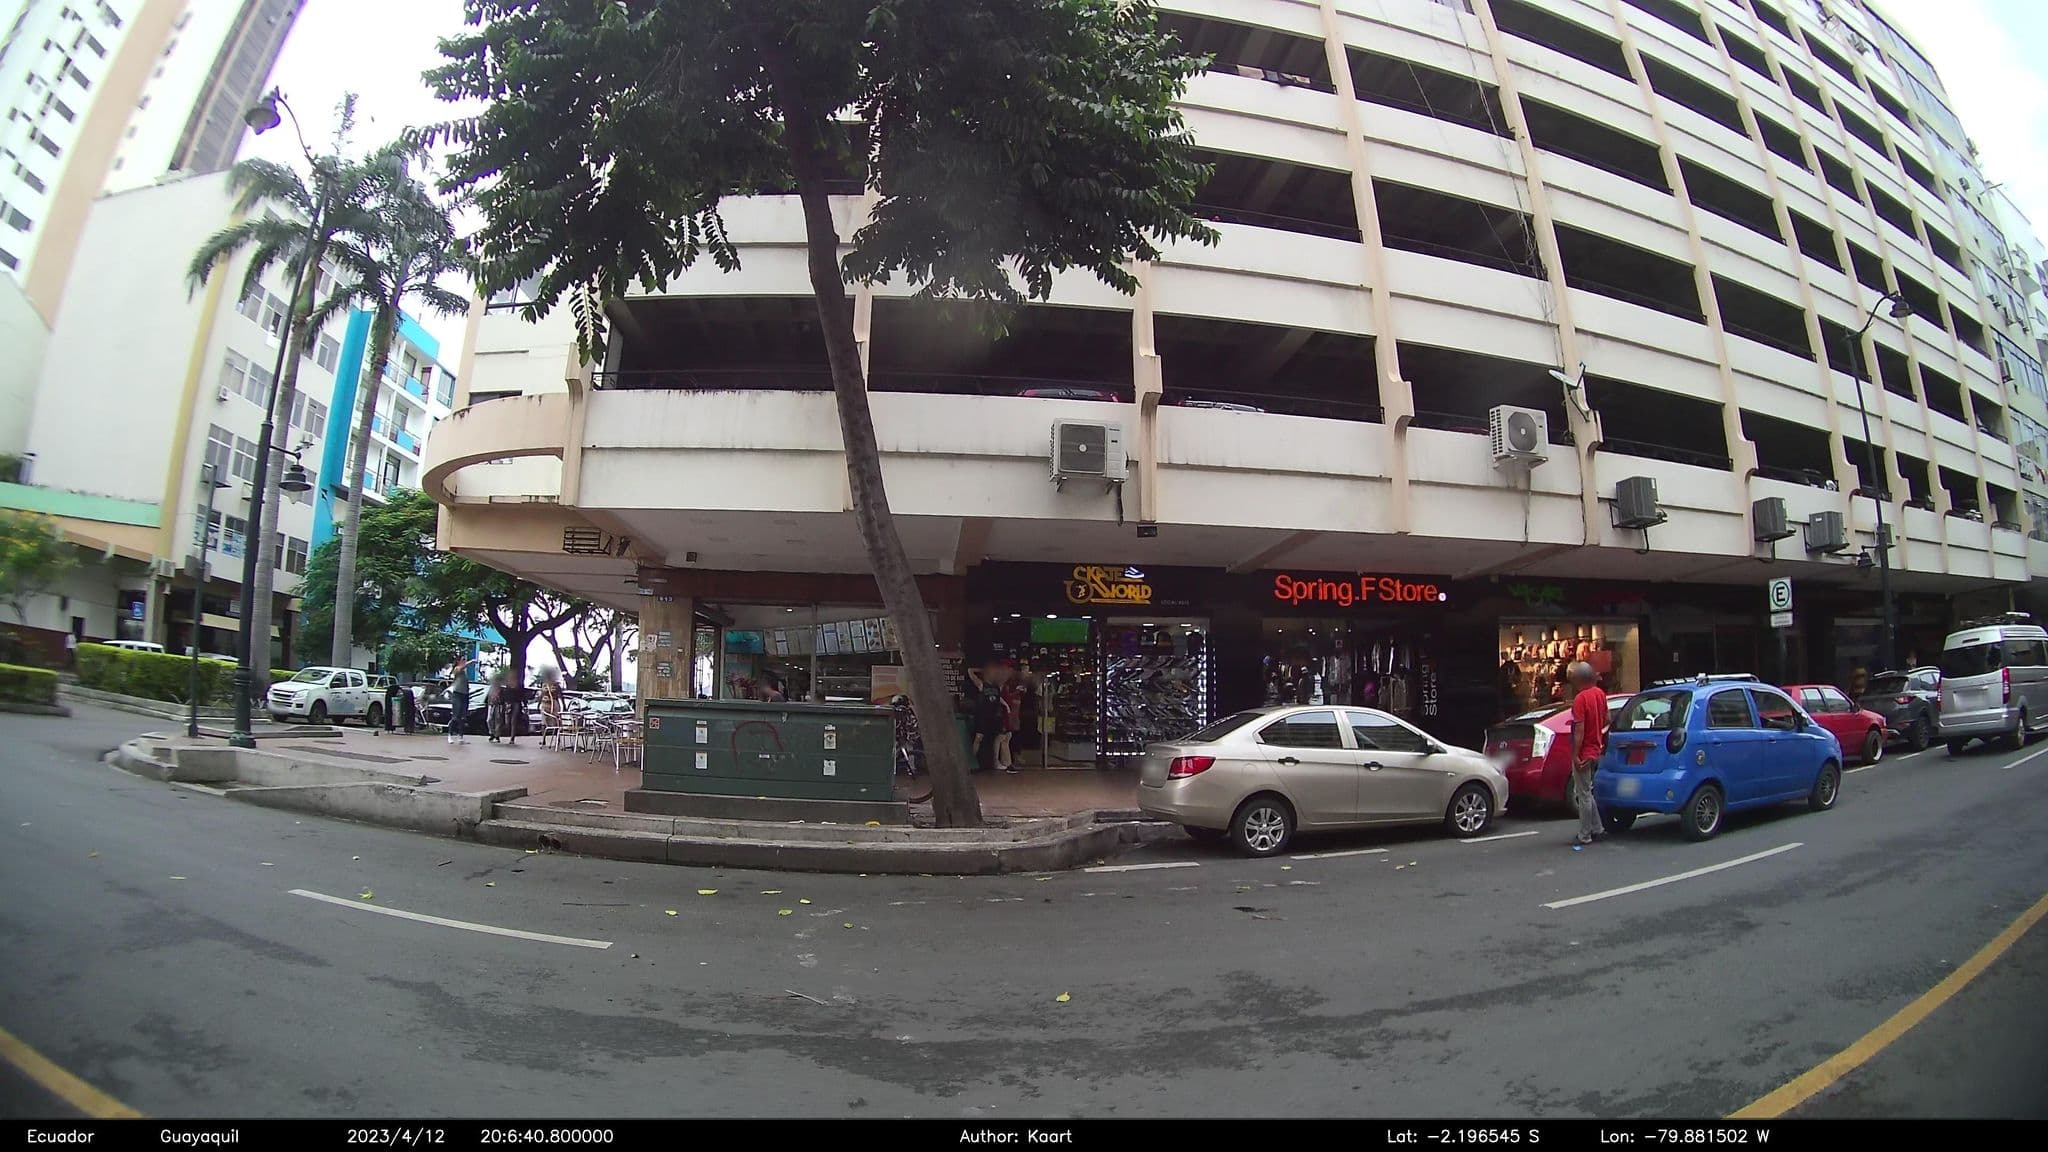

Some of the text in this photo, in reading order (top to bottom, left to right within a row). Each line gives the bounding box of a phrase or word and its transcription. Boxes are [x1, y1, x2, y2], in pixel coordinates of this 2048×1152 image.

[1073, 565, 1125, 582] SKATE
[1091, 583, 1153, 600] WORLD
[1776, 586, 1786, 602] E
